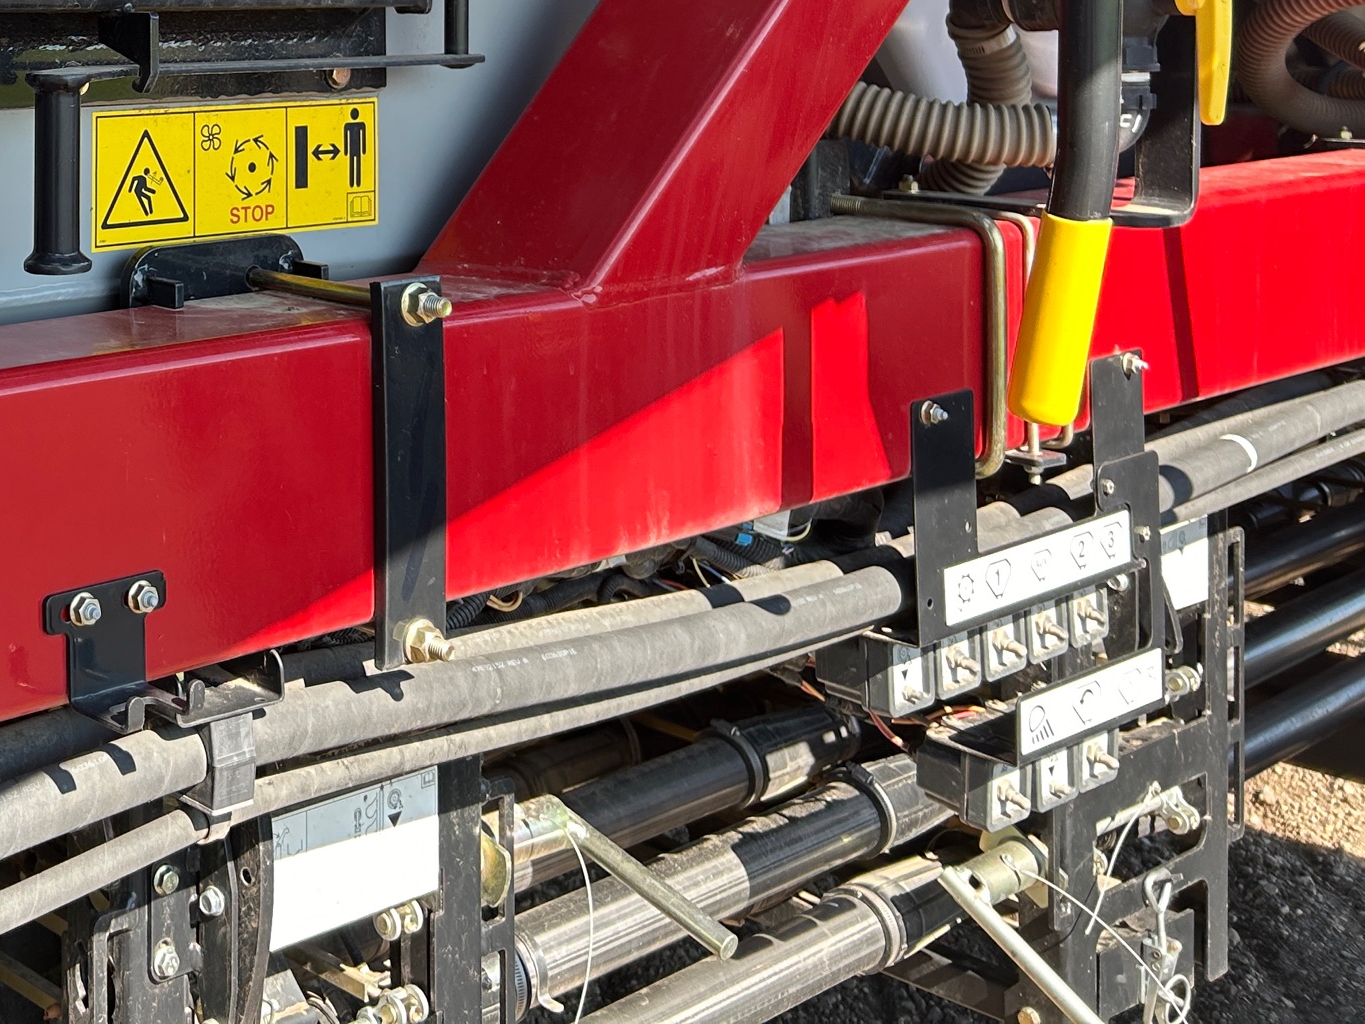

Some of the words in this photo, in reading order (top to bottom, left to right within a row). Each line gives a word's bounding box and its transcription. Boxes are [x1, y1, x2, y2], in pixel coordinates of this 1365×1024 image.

[229, 204, 275, 224] STOP
[1108, 530, 1115, 548] 3
[1078, 540, 1086, 558] 2
[994, 568, 1001, 586] 1
